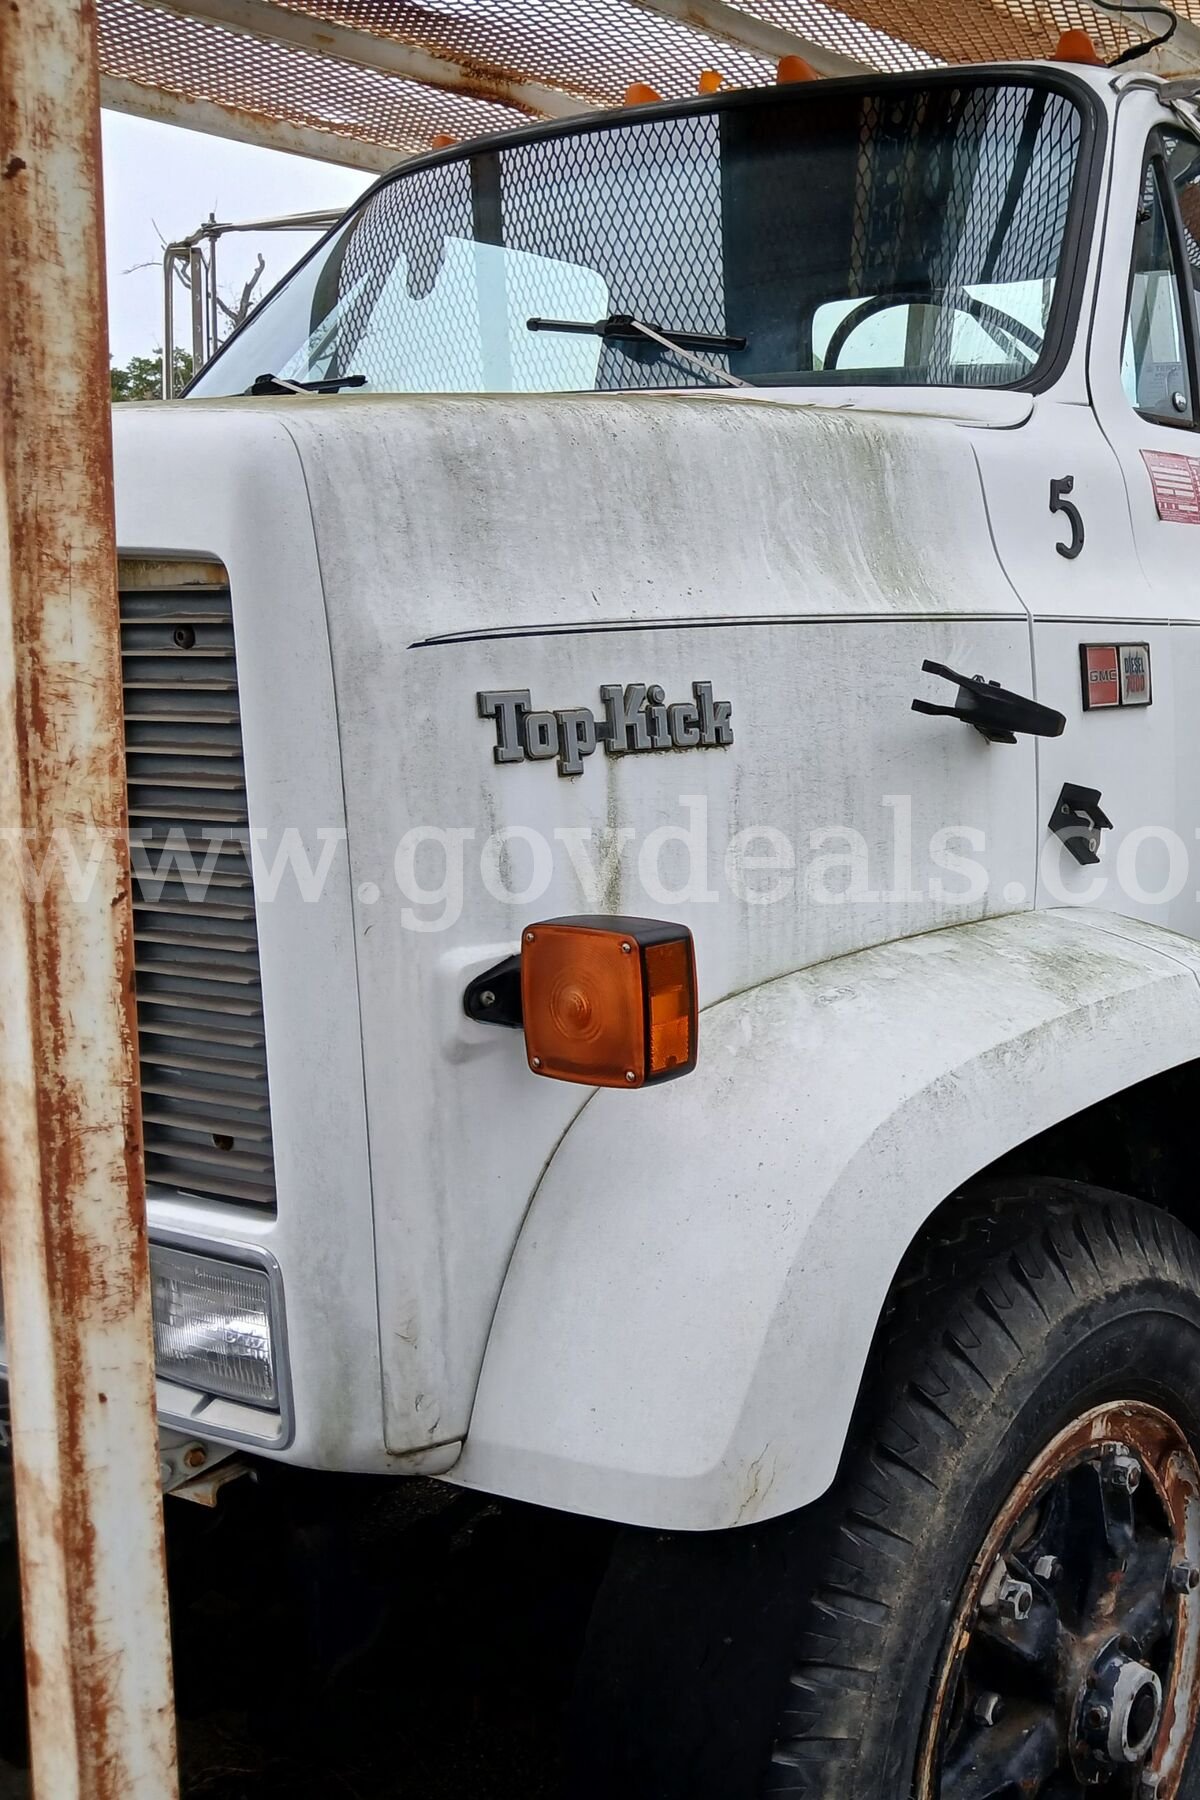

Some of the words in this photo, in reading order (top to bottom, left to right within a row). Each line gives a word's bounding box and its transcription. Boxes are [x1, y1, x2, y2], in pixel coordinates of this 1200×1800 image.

[1049, 475, 1085, 560] 5
[1124, 654, 1145, 674] DIESEL
[1089, 669, 1118, 682] GMC
